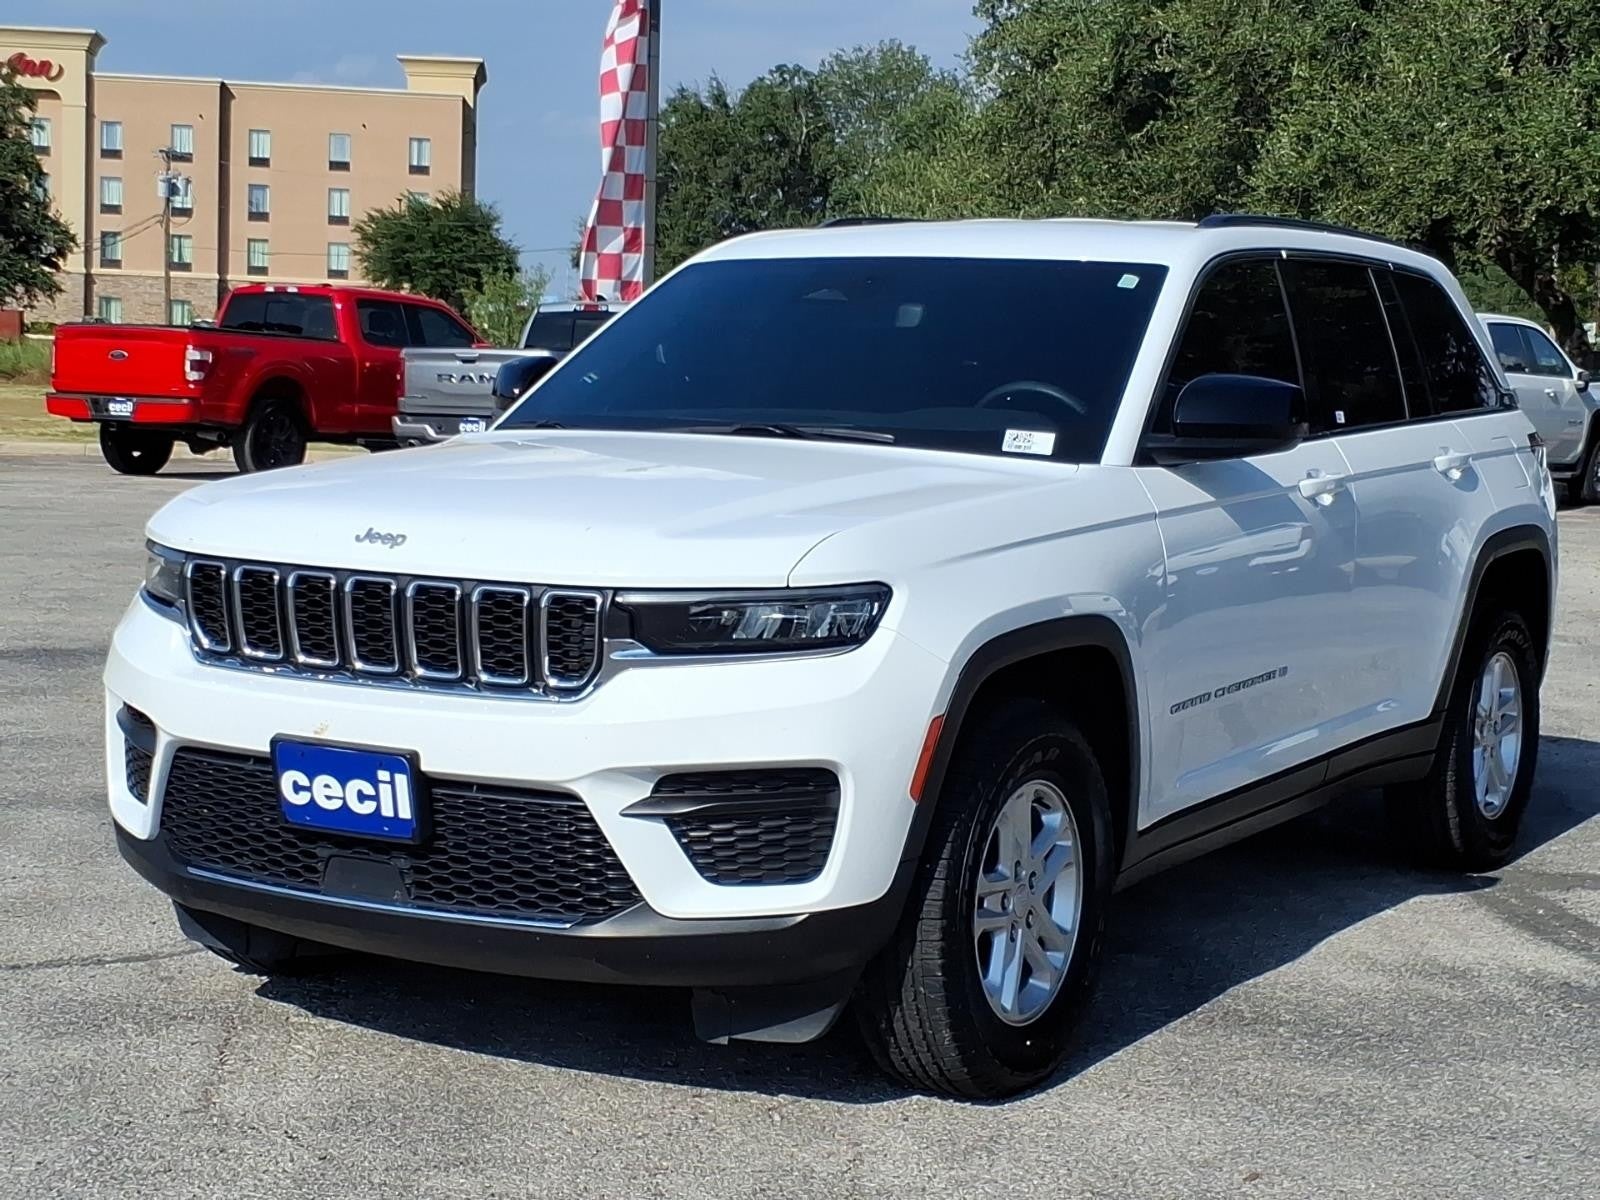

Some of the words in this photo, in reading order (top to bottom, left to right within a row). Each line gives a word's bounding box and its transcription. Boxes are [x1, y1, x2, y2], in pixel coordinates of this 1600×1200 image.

[8, 52, 54, 79] Inn
[436, 373, 497, 384] RAM
[355, 527, 407, 549] Jeep
[280, 769, 412, 820] cecil
